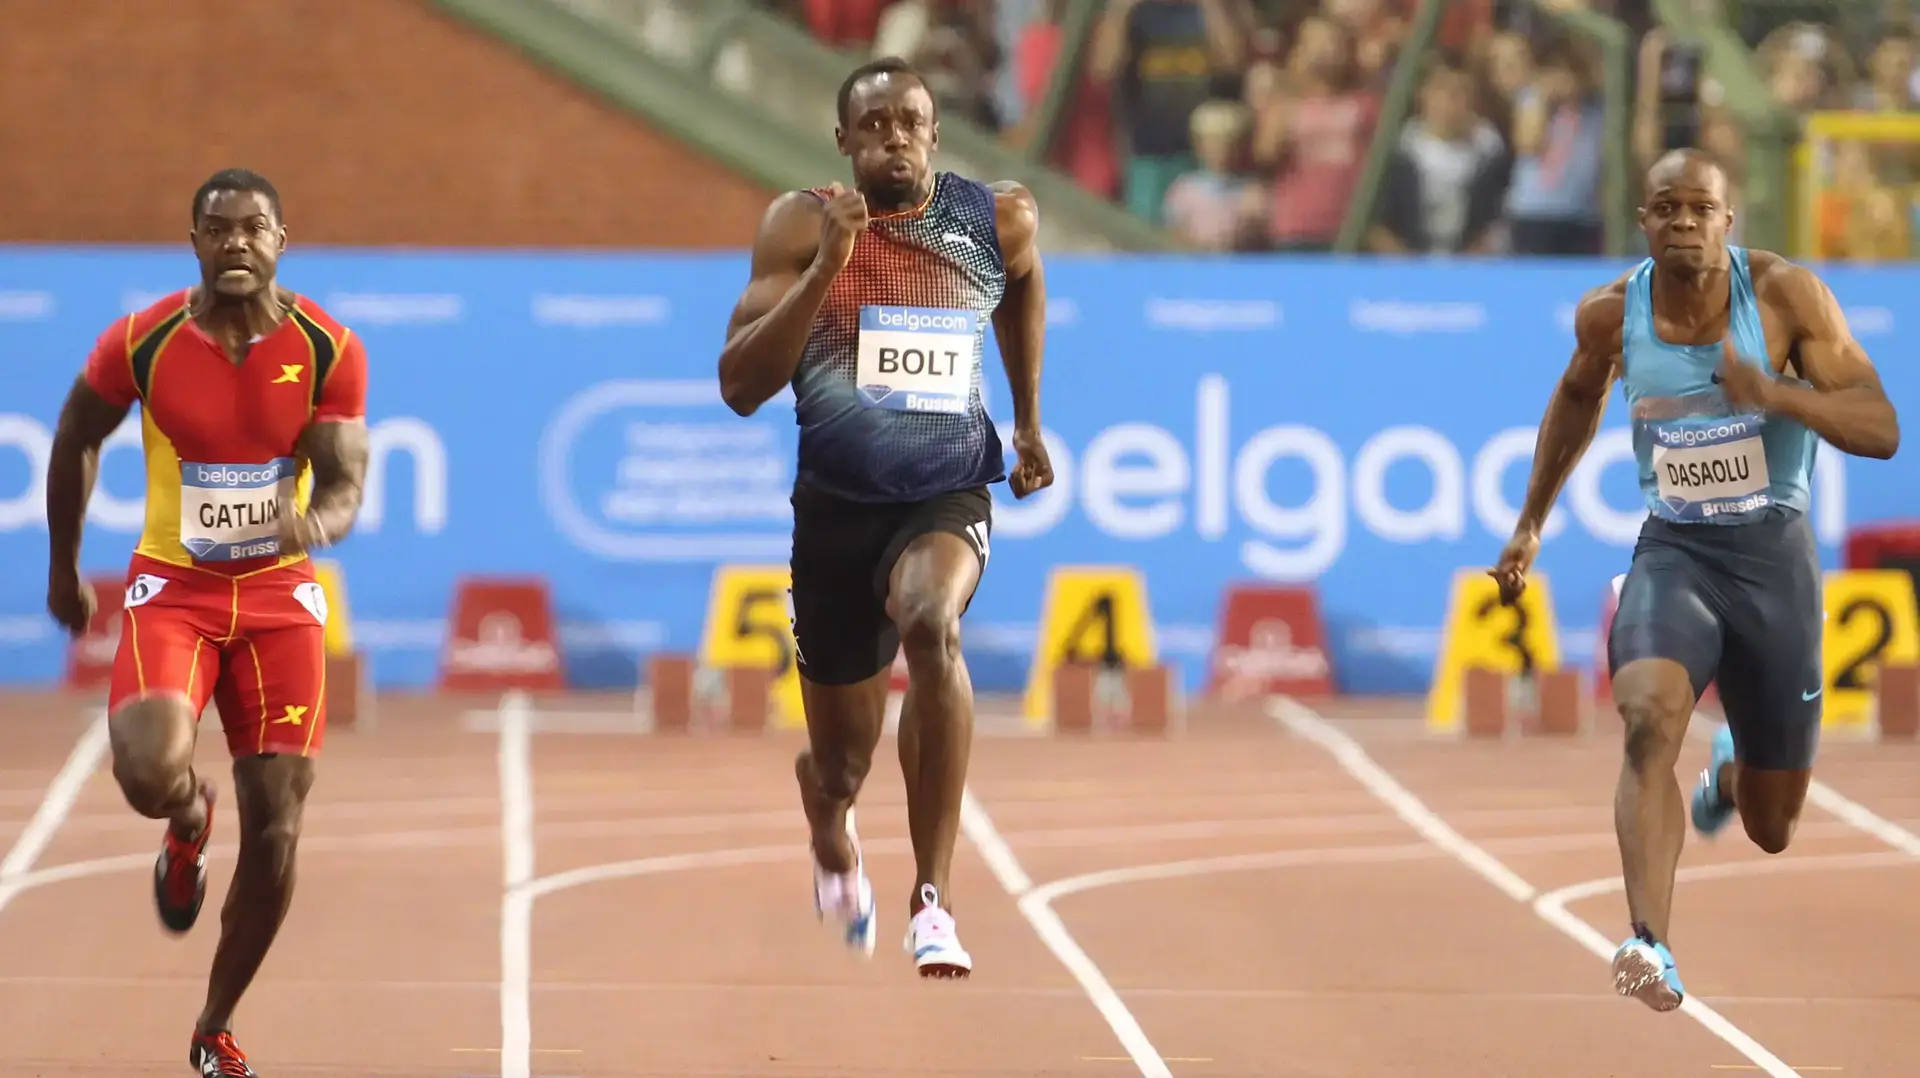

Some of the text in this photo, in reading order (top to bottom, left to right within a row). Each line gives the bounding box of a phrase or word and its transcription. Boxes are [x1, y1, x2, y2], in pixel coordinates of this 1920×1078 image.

[878, 308, 967, 331] belgacom
[878, 347, 959, 376] BOLT
[1658, 422, 1746, 446] belgacom
[977, 372, 1847, 582] belgaco
[1666, 454, 1749, 487] DASAOLU
[1701, 494, 1768, 517] Brussels
[734, 585, 790, 680] 5
[1058, 587, 1124, 668] 4
[1832, 594, 1893, 690] 2
